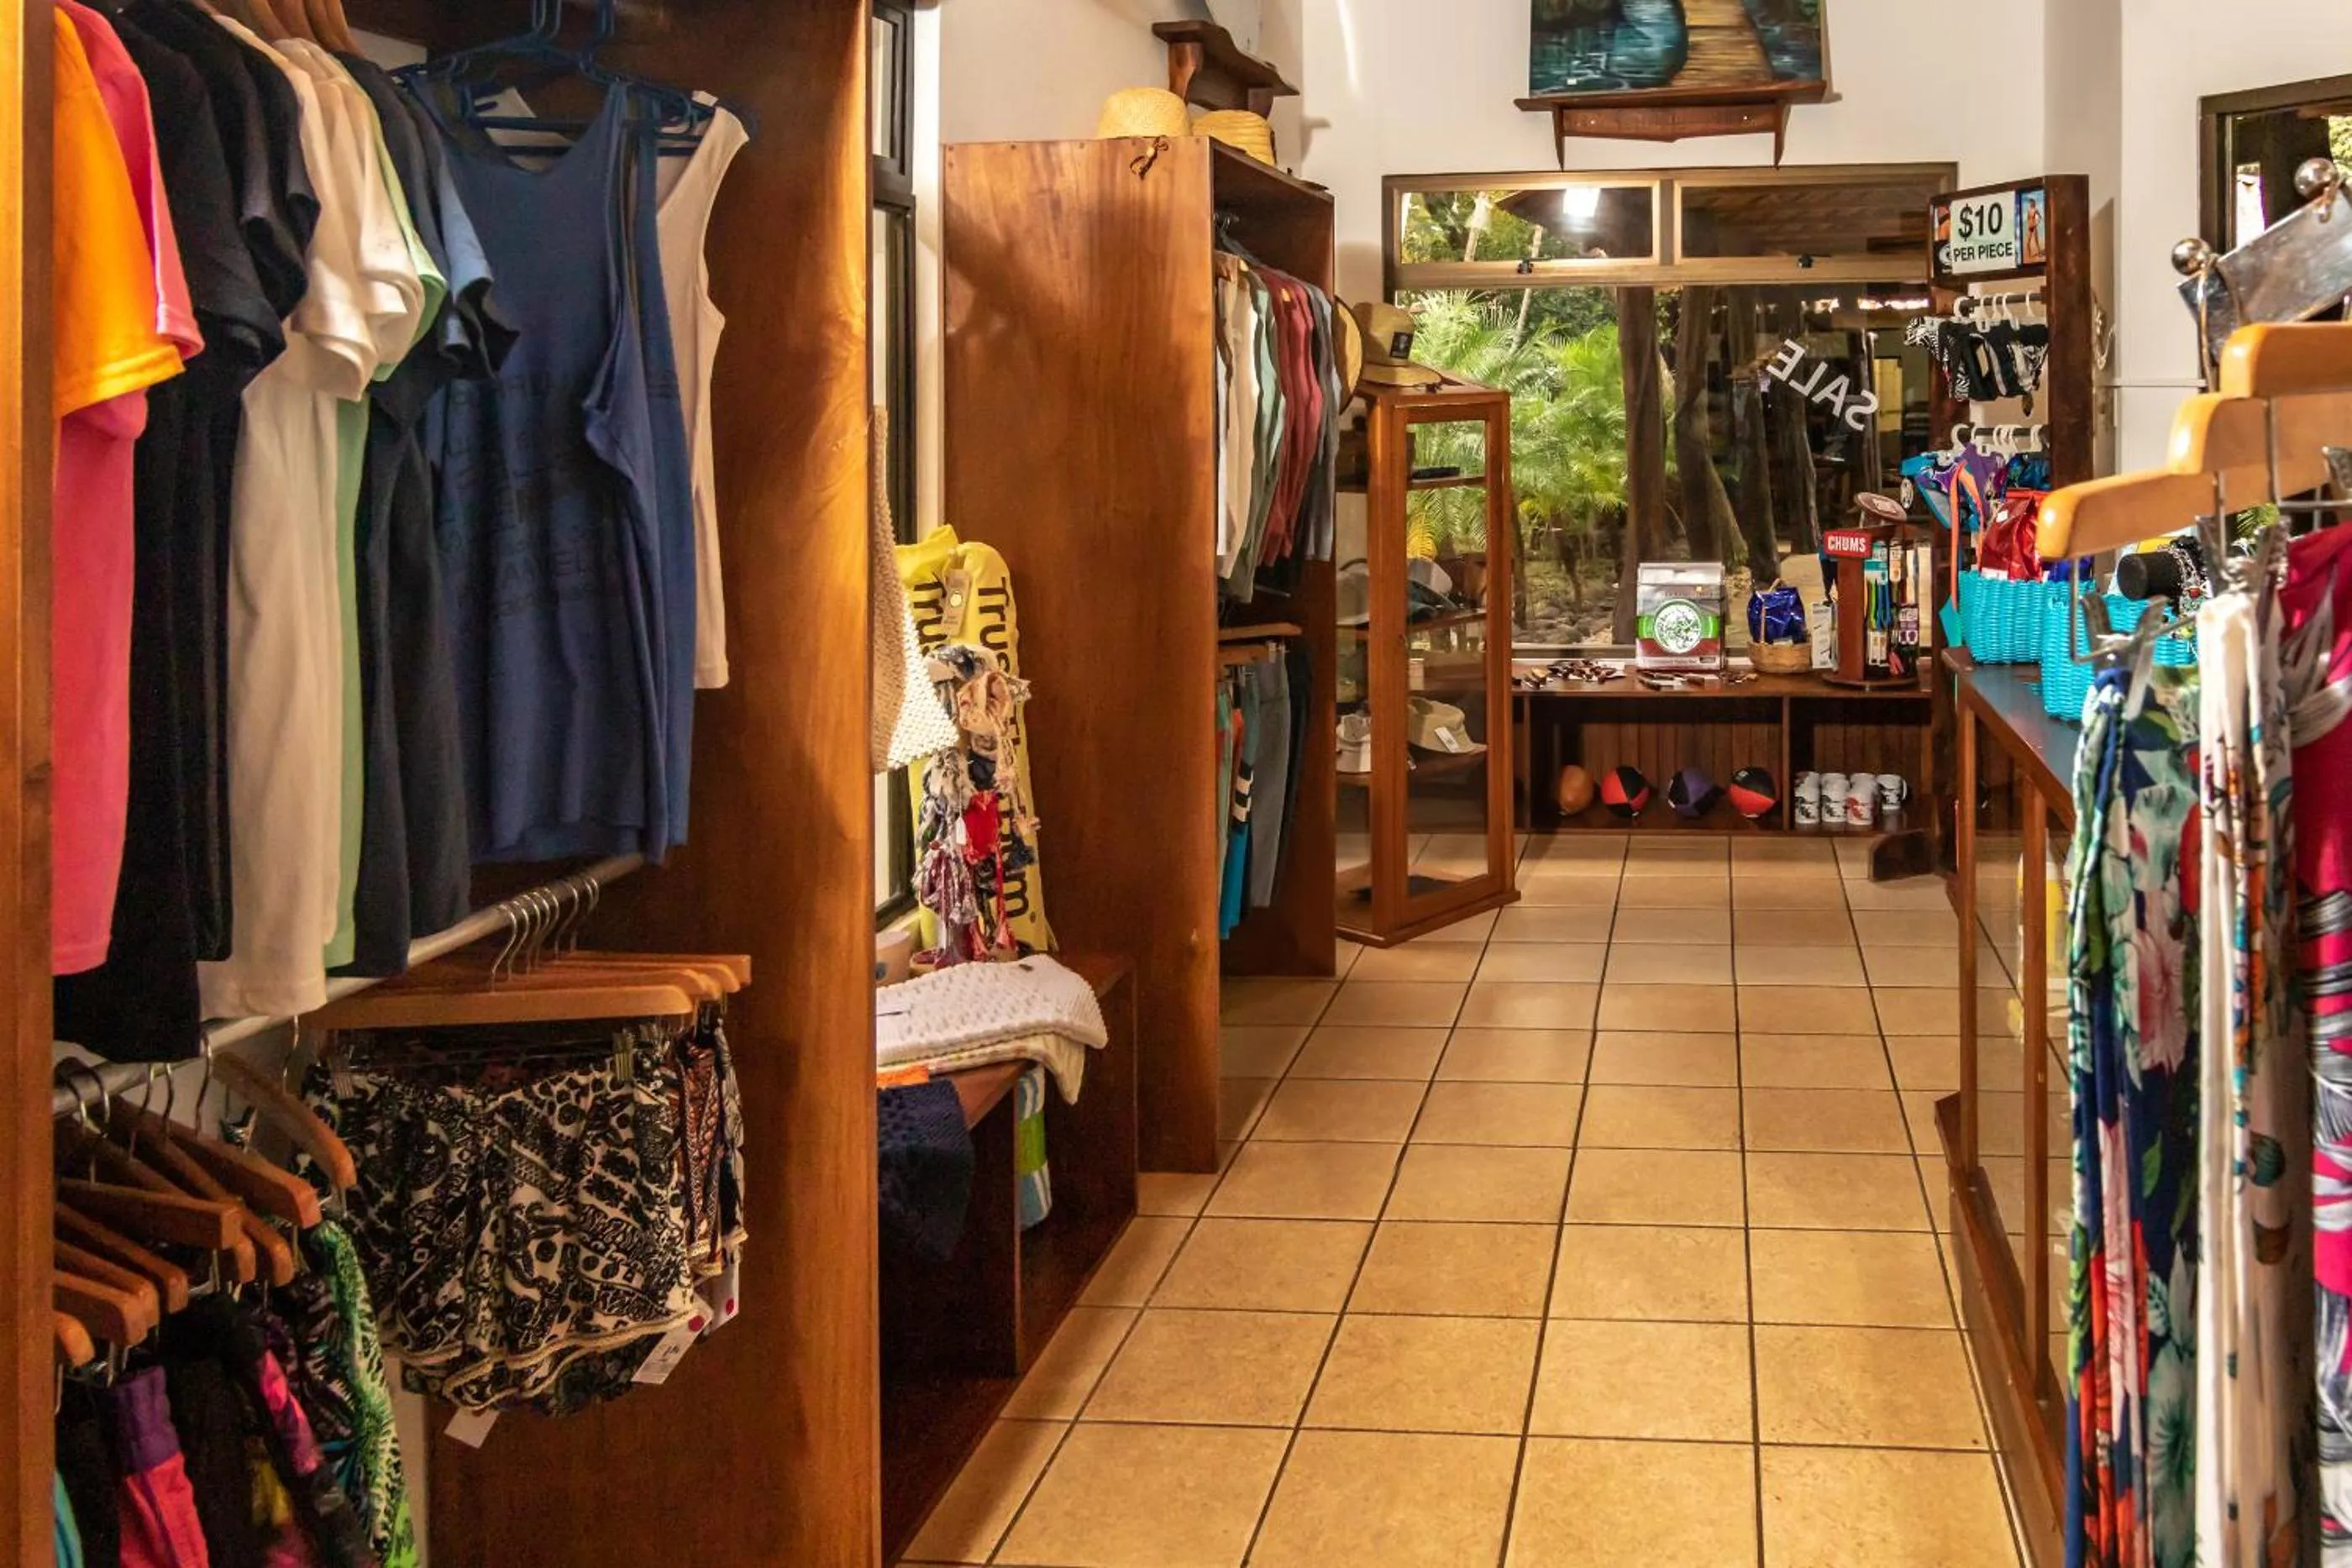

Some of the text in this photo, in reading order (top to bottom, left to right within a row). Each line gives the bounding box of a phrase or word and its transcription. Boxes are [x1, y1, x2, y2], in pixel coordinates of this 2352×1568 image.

[1958, 203, 2003, 242] $10
[1953, 242, 2013, 262] PER PIECE
[1828, 535, 1866, 553] CHUMS
